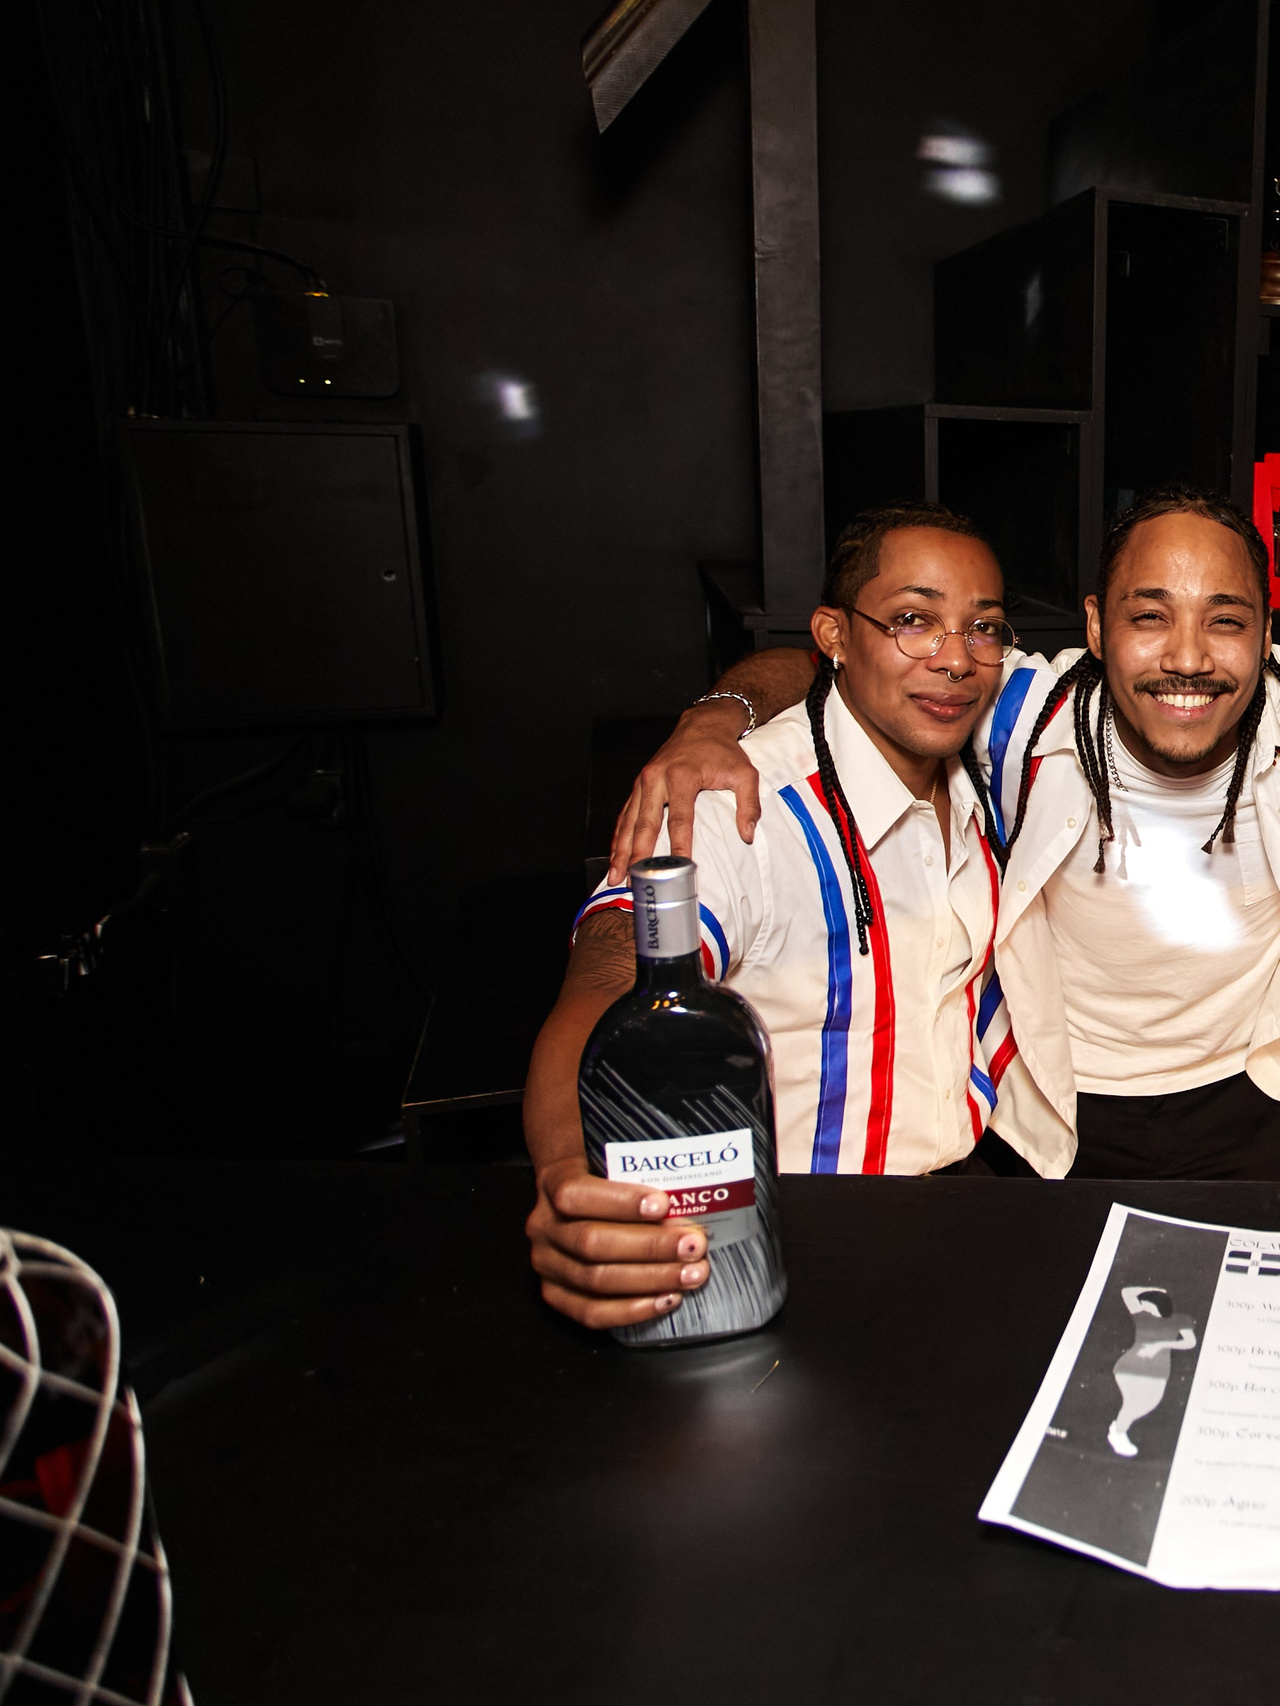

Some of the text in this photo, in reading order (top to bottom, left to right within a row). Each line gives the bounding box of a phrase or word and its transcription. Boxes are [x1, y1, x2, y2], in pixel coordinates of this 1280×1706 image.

[642, 885, 659, 949] BARCELÓ
[620, 1142, 739, 1173] BARCELÓ
[663, 1170, 722, 1182] DOMINICANO
[668, 1188, 730, 1207] ANCO
[669, 1206, 707, 1216] ÑEJADO
